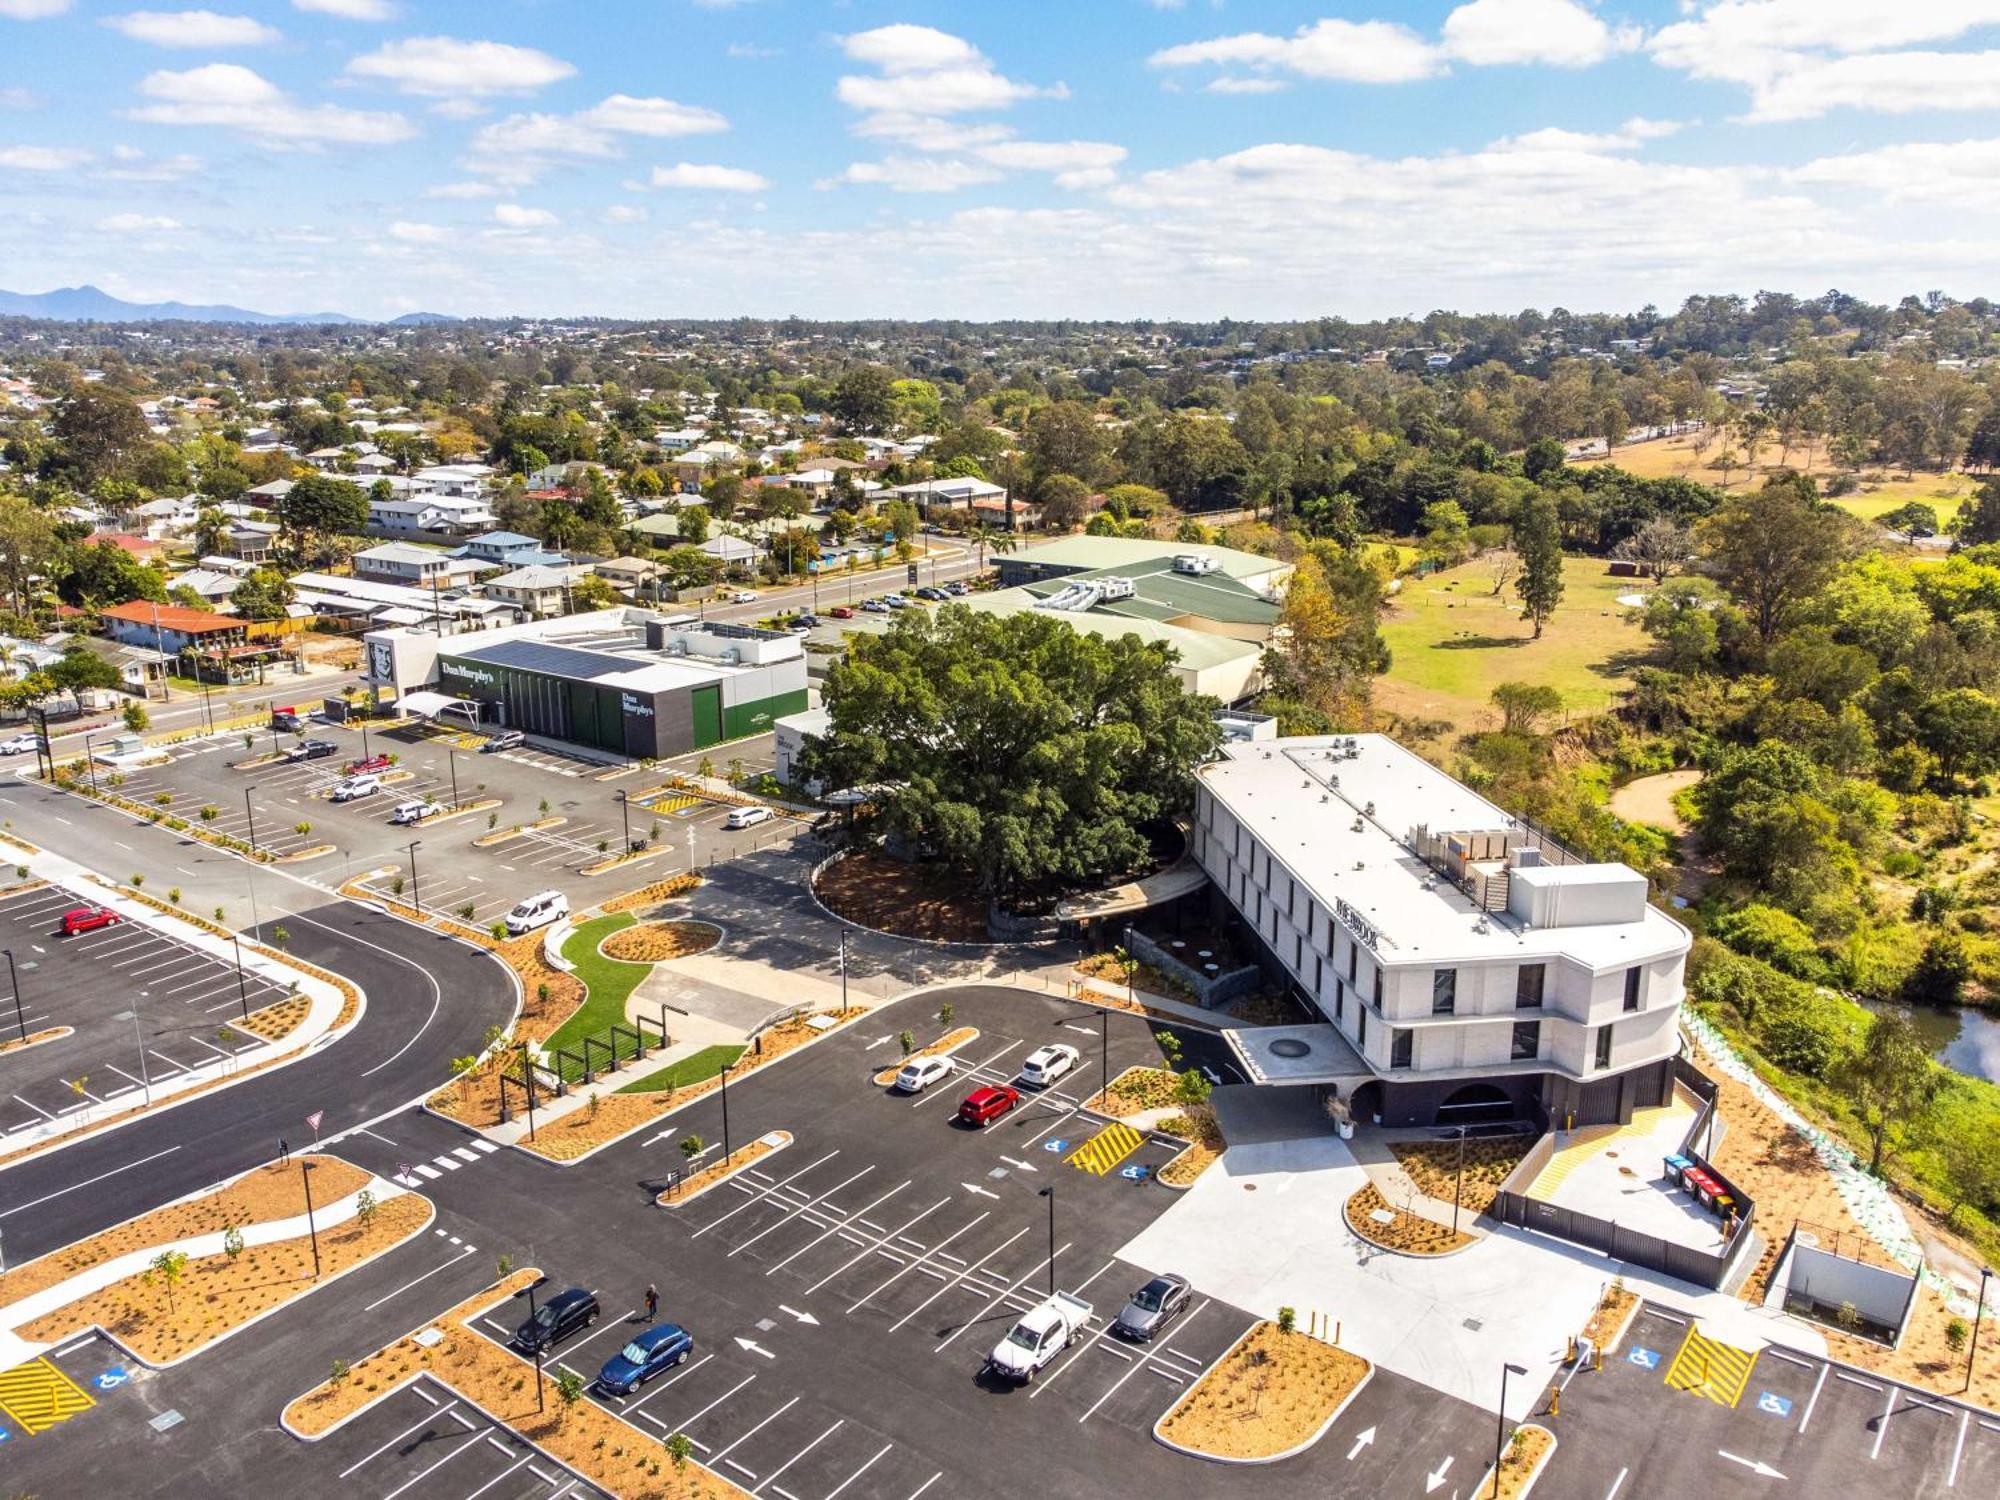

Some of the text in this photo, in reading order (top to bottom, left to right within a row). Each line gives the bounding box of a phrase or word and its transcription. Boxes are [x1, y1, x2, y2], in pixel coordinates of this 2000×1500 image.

[442, 662, 494, 685] Don Murphy's
[622, 692, 637, 704] Don
